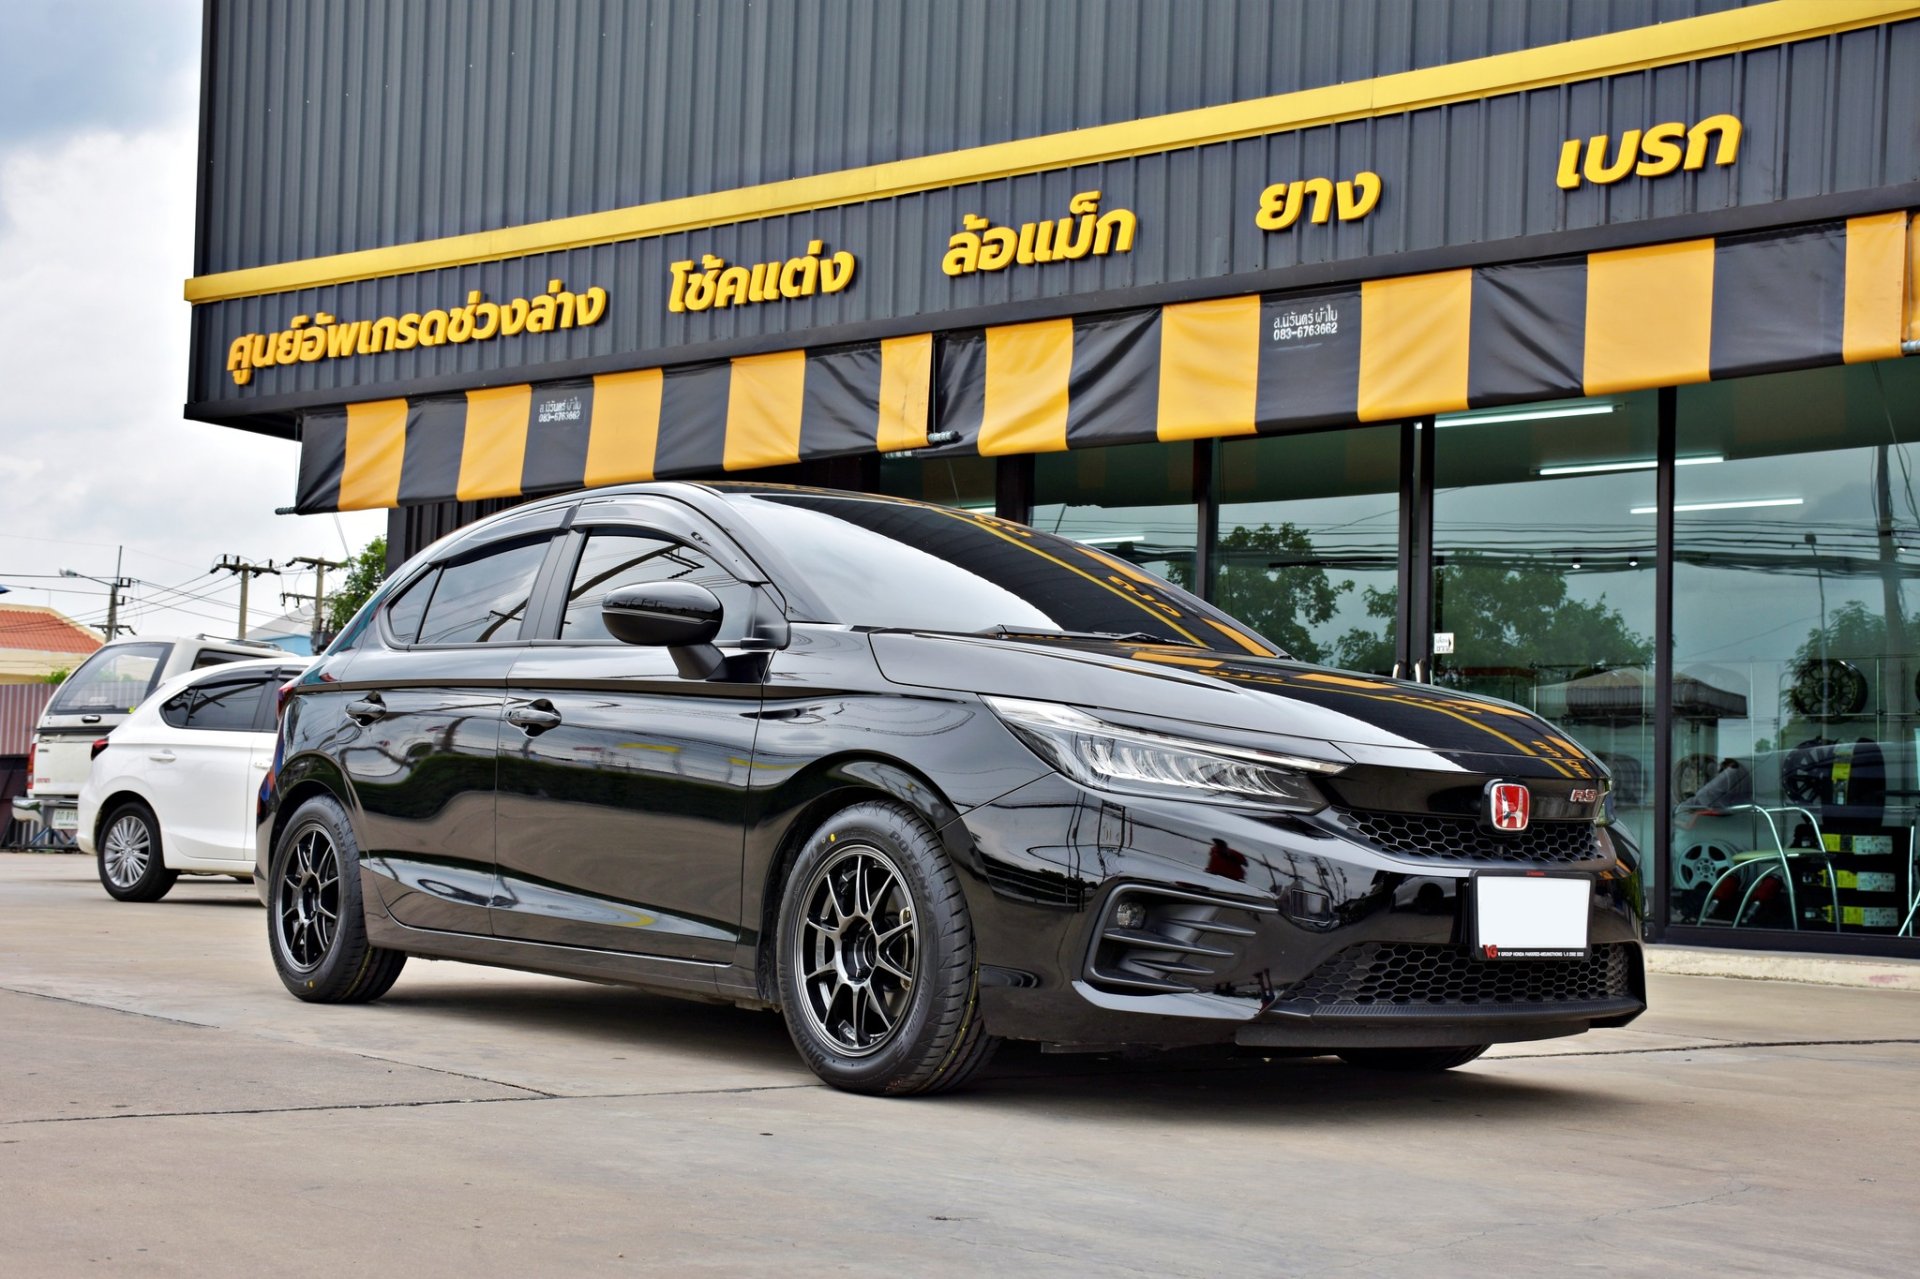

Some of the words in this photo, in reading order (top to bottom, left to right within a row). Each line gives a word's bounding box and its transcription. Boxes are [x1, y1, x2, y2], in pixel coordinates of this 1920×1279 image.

[226, 278, 606, 386] ศูนย์อัพเกรดช่วงล่าง
[668, 238, 855, 313] โช้คแต่ง
[941, 189, 1137, 276] ล้อแม็ก
[1256, 171, 1382, 232] ยาง
[1556, 113, 1743, 190] เบรก
[1273, 321, 1338, 341] 083-6763662
[1570, 789, 1598, 802] RS
